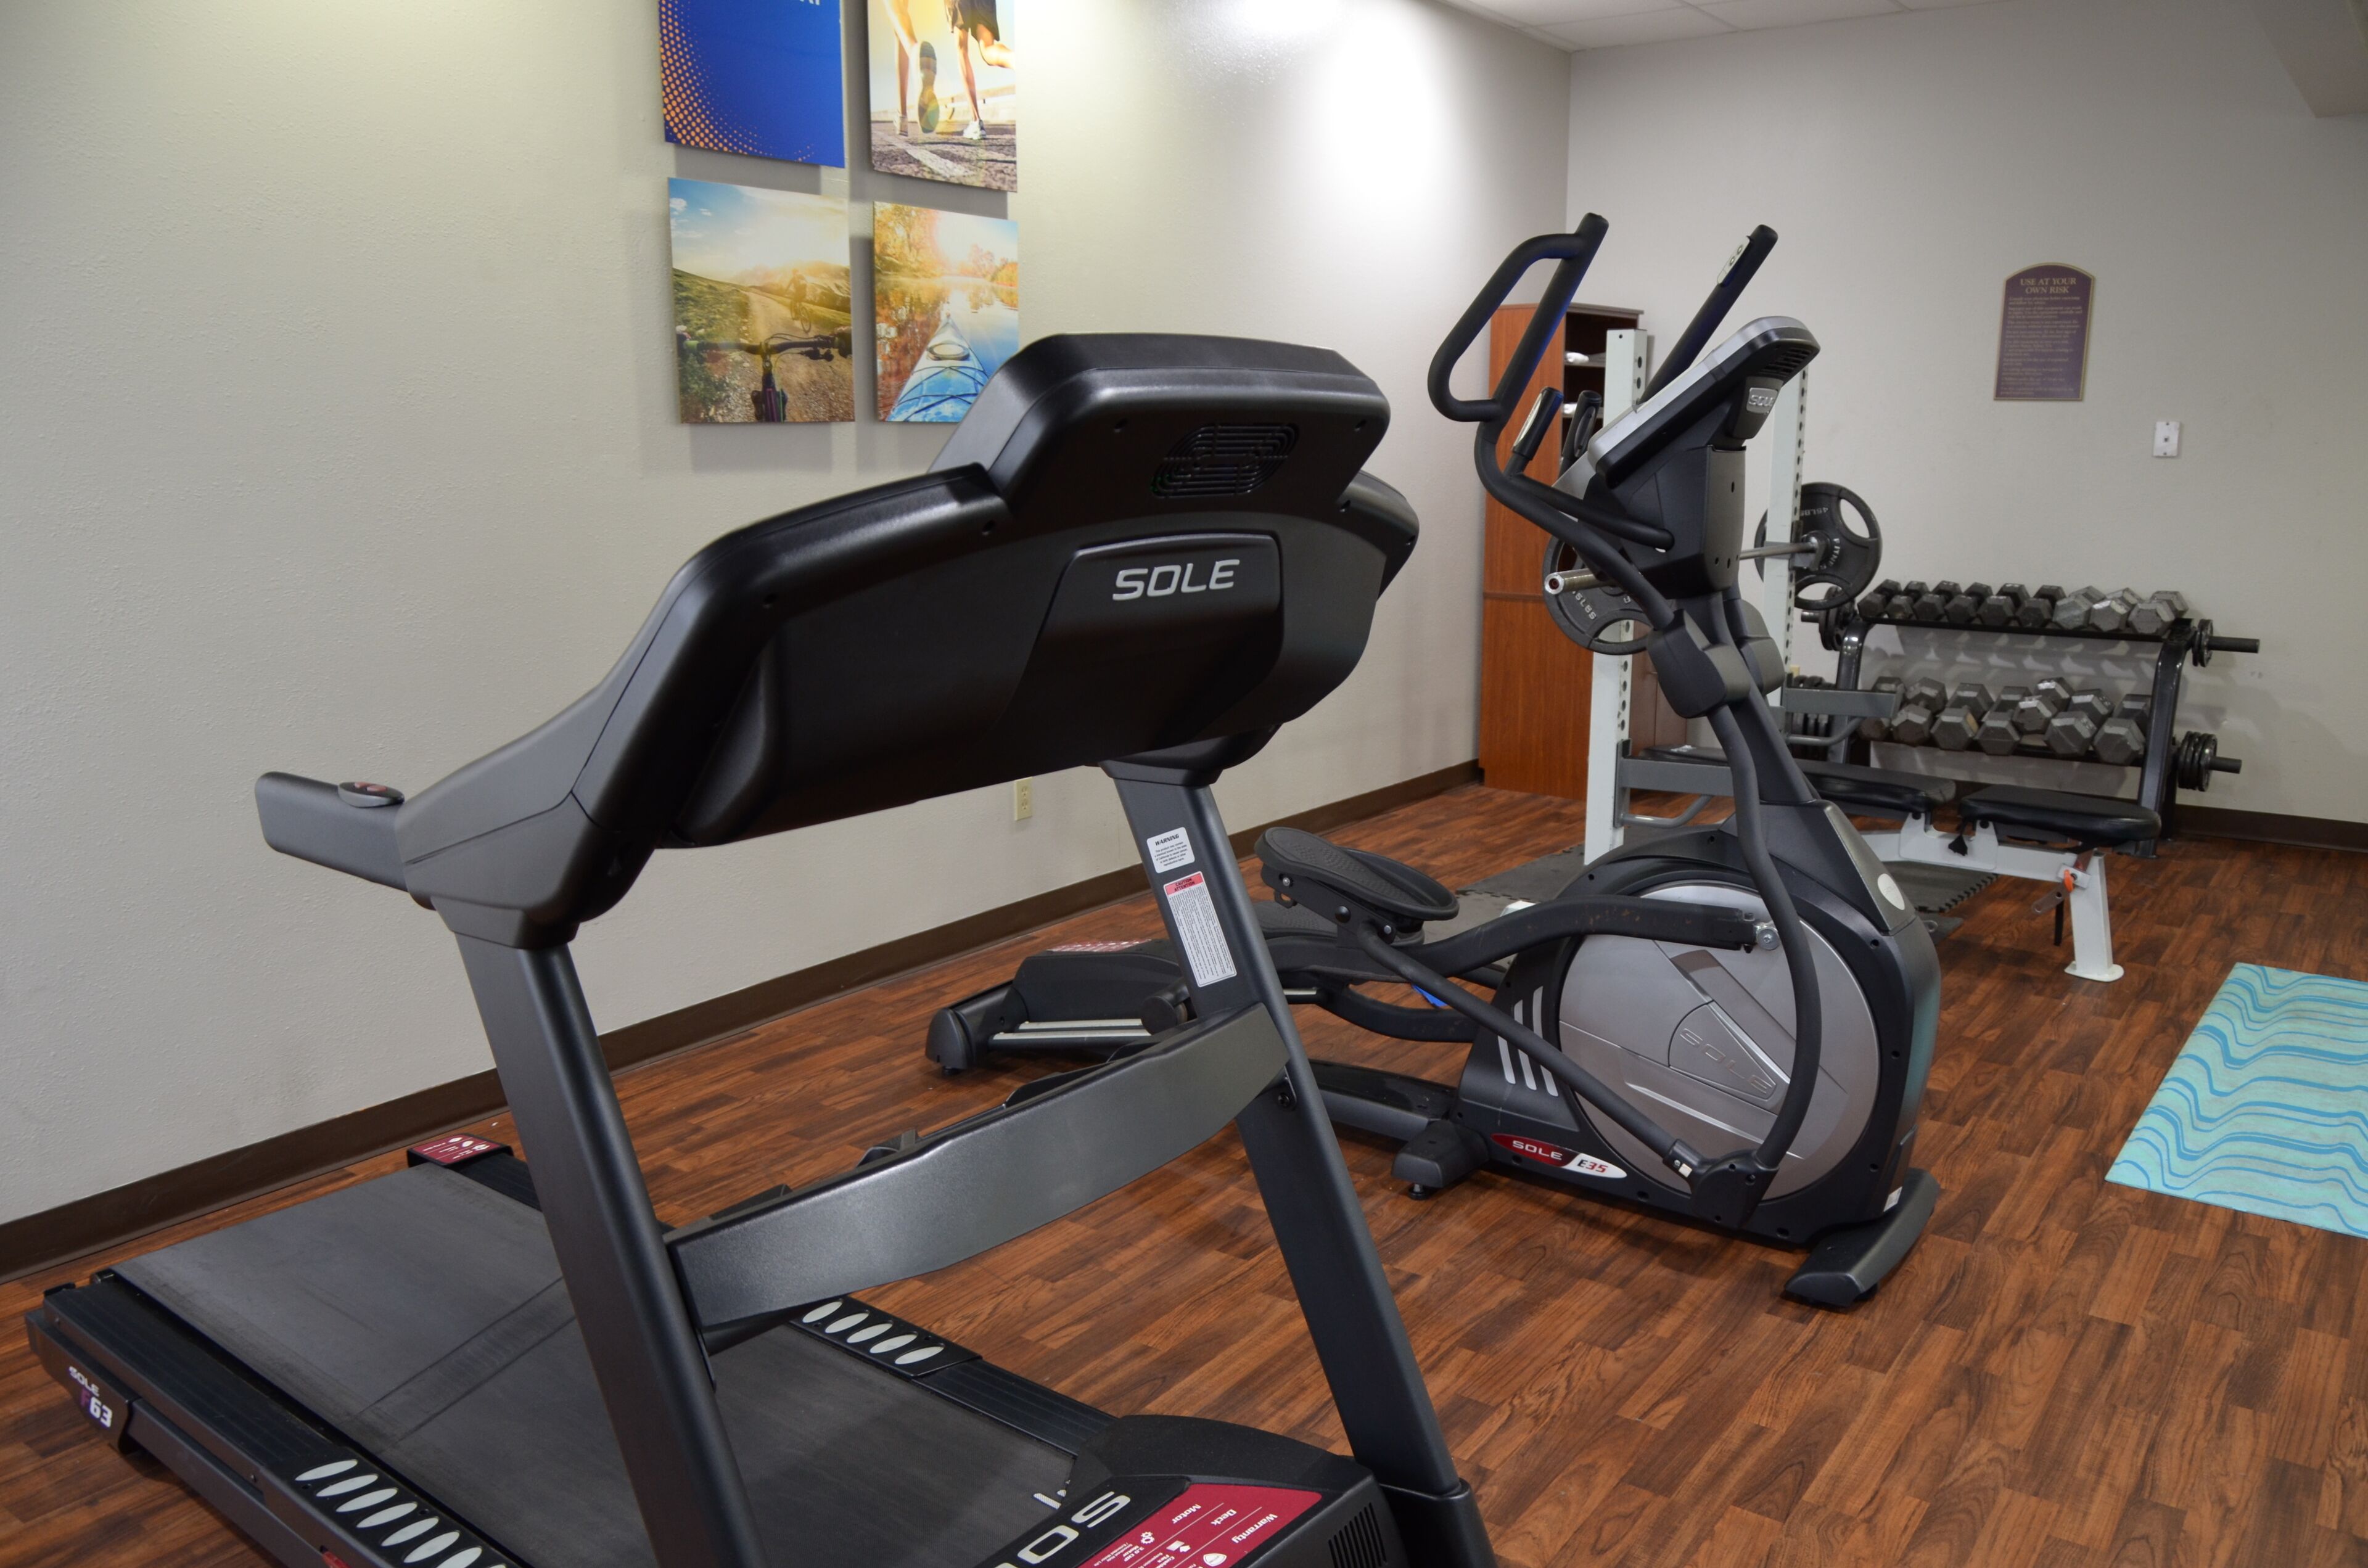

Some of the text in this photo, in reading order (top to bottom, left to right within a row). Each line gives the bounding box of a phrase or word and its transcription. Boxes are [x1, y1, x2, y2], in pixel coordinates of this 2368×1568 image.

[2025, 285, 2069, 294] OWN RISK
[2038, 277, 2050, 285] AT
[2052, 277, 2076, 285] YOUR
[1112, 559, 1240, 601] SOLE
[1155, 834, 1180, 845] WARNING
[1174, 881, 1195, 892] ATTENTION
[1175, 878, 1192, 886] CAUTION
[1679, 1027, 1772, 1094] SOLE
[1513, 1139, 1608, 1173] SOLE E35
[69, 1366, 100, 1397] SOLE
[80, 1387, 113, 1428] F63
[1172, 1502, 1201, 1526] Motor
[1211, 1508, 1237, 1529] Deck
[1232, 1511, 1277, 1546] Warranty
